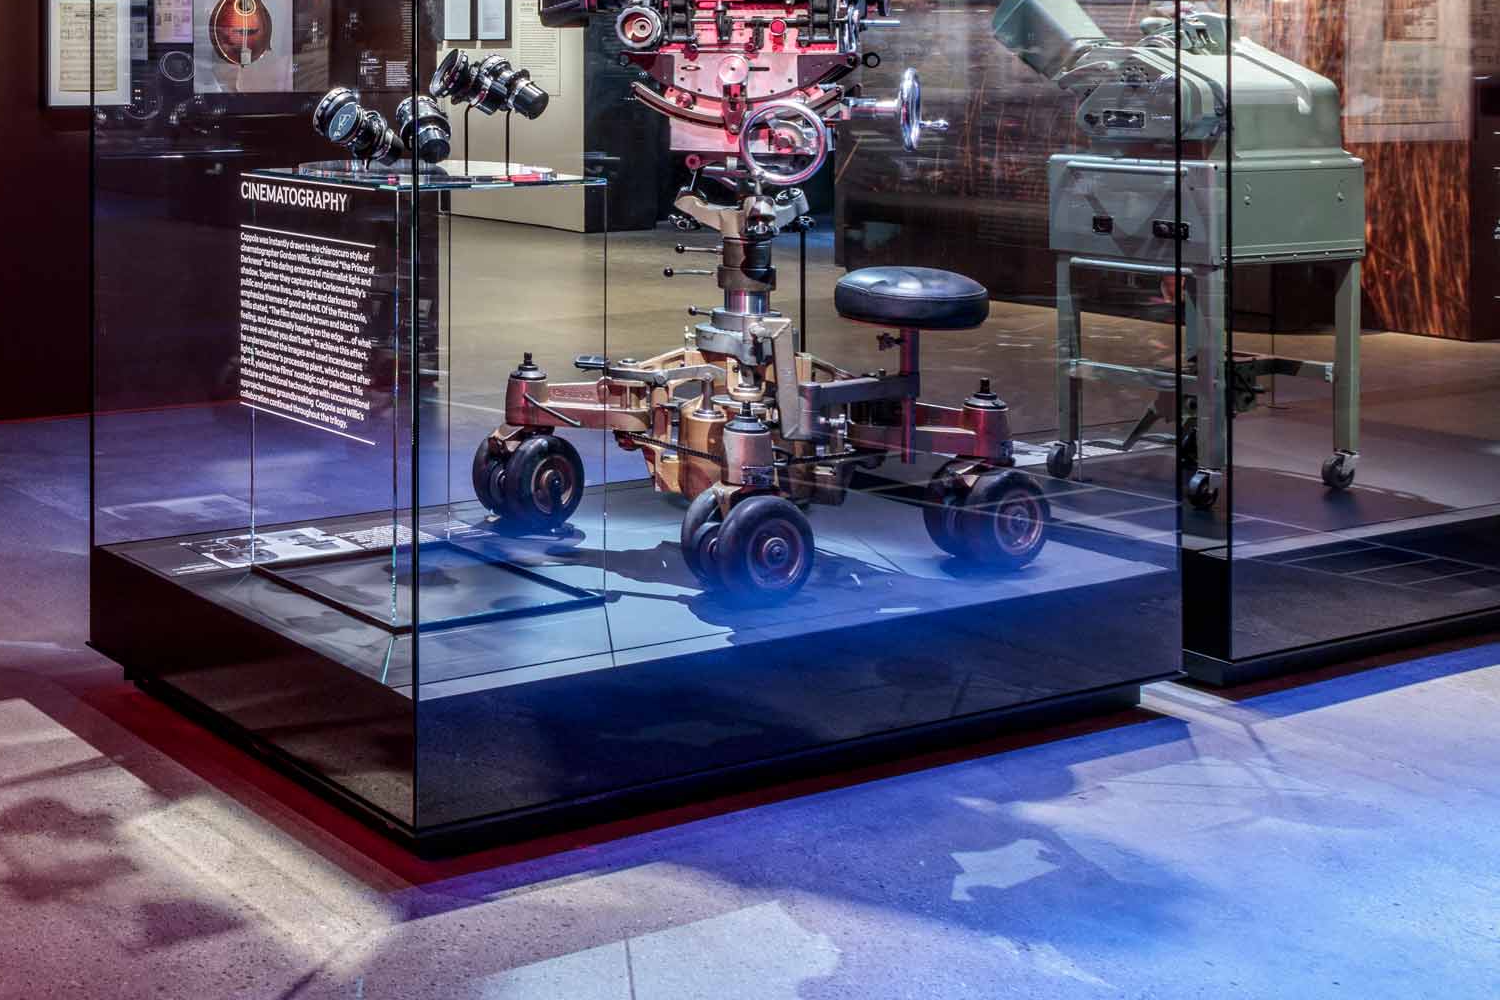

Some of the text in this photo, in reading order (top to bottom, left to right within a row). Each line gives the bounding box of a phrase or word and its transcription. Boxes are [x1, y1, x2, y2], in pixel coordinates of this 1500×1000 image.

[241, 181, 348, 212] CINEMATOGRAPHY
[240, 232, 258, 244] Coppola
[268, 236, 289, 249] instantly
[290, 239, 304, 250] drawn
[311, 243, 319, 252] the
[320, 244, 348, 257] chiaroscuro
[350, 249, 362, 262] style
[279, 249, 296, 260] Gordon
[311, 255, 338, 268] nicknamed
[351, 262, 367, 273] Prince
[259, 268, 279, 282] Together
[279, 272, 290, 284] they
[290, 275, 312, 289] captured
[313, 279, 321, 288] the
[322, 281, 344, 293] Corleone
[279, 261, 293, 273] daring
[294, 264, 315, 275] embrace
[322, 269, 348, 282] minimalist
[348, 273, 360, 286] light
[361, 276, 371, 286] and
[240, 276, 254, 288] public
[254, 279, 263, 288] and
[263, 281, 279, 294] private
[292, 287, 305, 299] using
[306, 289, 316, 301] light
[317, 292, 327, 302] and
[328, 294, 350, 307] darkness
[264, 292, 282, 304] themes
[288, 298, 300, 310] good
[301, 300, 310, 310] and
[328, 306, 336, 316] the
[338, 308, 348, 318] first
[240, 298, 252, 309] Willis
[280, 307, 289, 317] film
[290, 310, 305, 321] should
[313, 314, 329, 326] brown
[330, 318, 339, 328] and
[340, 320, 353, 332] black
[240, 323, 248, 332] you
[257, 325, 266, 335] and
[267, 327, 278, 338] what
[279, 332, 288, 342] you
[320, 340, 338, 352] achieve
[340, 344, 349, 355] this
[257, 314, 266, 323] and
[266, 316, 294, 332] occasionally
[294, 322, 313, 336] hanging
[322, 328, 330, 338] the
[357, 336, 371, 348] what
[246, 334, 278, 351] underexposed
[288, 344, 305, 358] images
[306, 348, 314, 358] and
[316, 351, 327, 362] used
[328, 354, 362, 371] incandescent
[240, 354, 250, 364] Part
[255, 358, 270, 372] yielded
[294, 368, 315, 384] nostalgic
[316, 374, 327, 386] color
[352, 384, 363, 395] This
[283, 354, 308, 371] processing
[324, 365, 339, 377] which
[340, 369, 356, 381] closed
[356, 373, 370, 385] after
[240, 388, 269, 404] collaboration
[270, 396, 292, 411] continued
[292, 403, 319, 421] throughout
[320, 411, 328, 422] the
[264, 372, 288, 386] traditional
[288, 379, 318, 397] technologies
[319, 387, 329, 398] with
[330, 390, 369, 409] unconventional
[267, 386, 276, 394] was
[315, 398, 335, 414] Coppola
[336, 404, 346, 415] and
